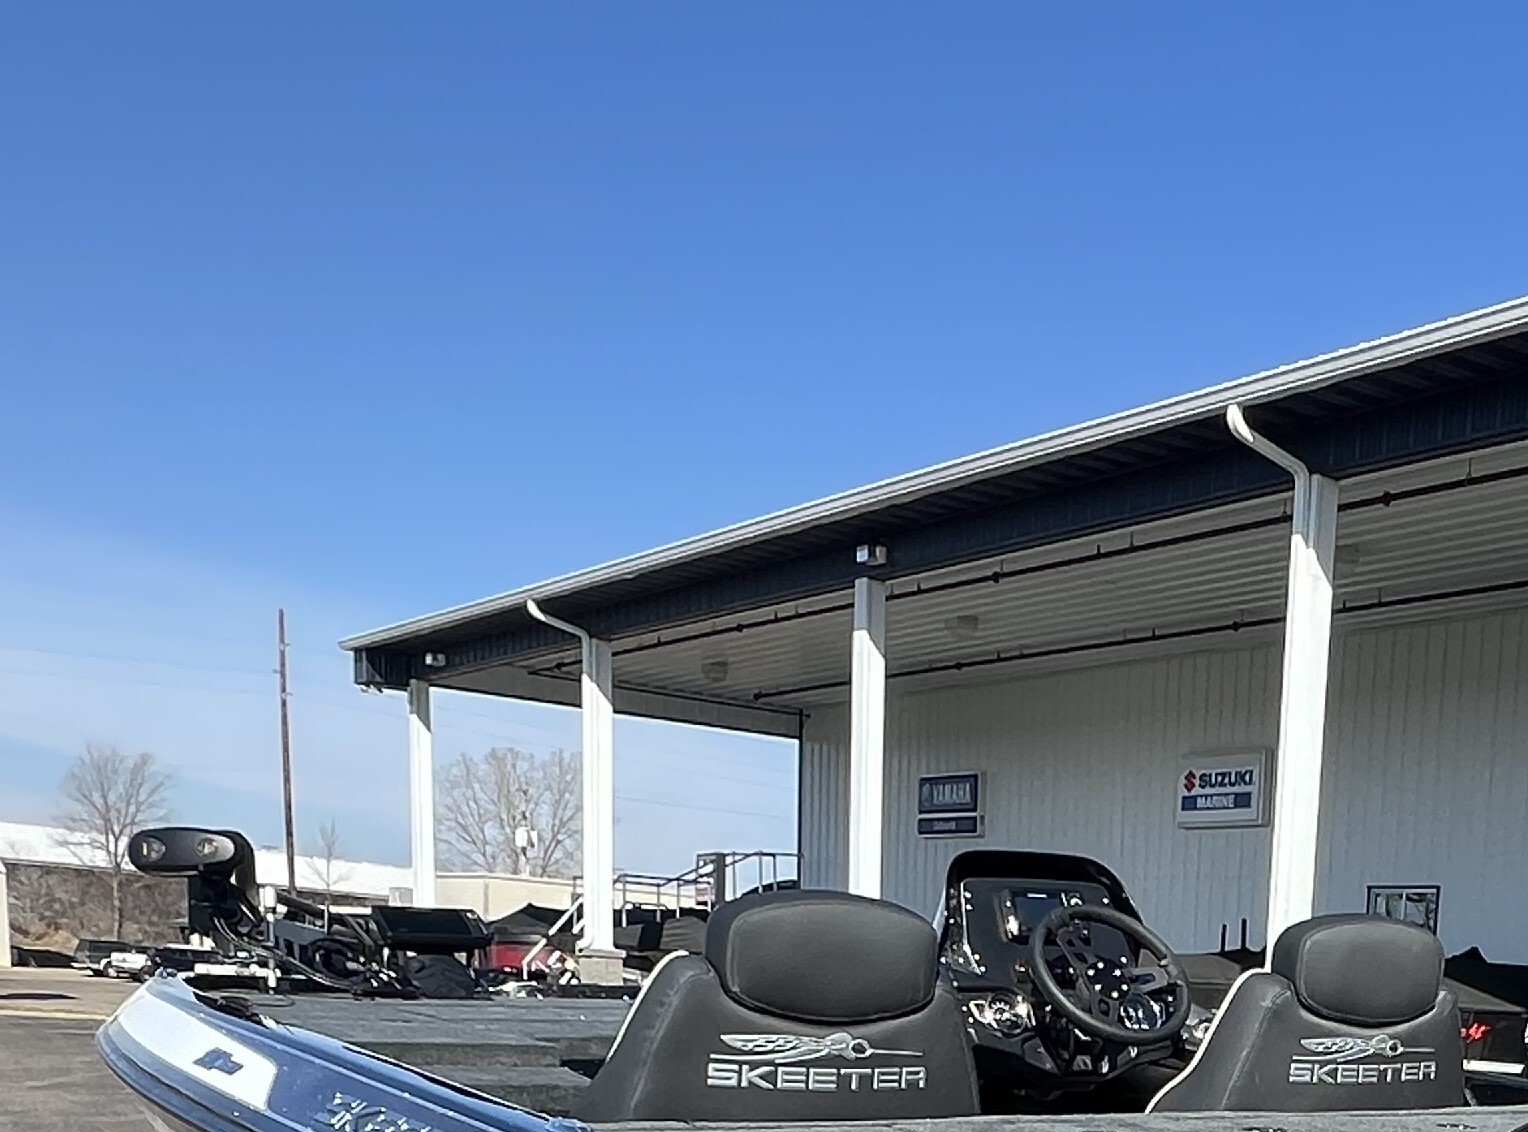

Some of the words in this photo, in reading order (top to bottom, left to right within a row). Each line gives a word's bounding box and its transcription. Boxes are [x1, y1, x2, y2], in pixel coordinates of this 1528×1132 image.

[1199, 769, 1254, 789] SUZUKI
[706, 1062, 927, 1092] SKEETER
[1289, 1061, 1436, 1085] SKEETER
